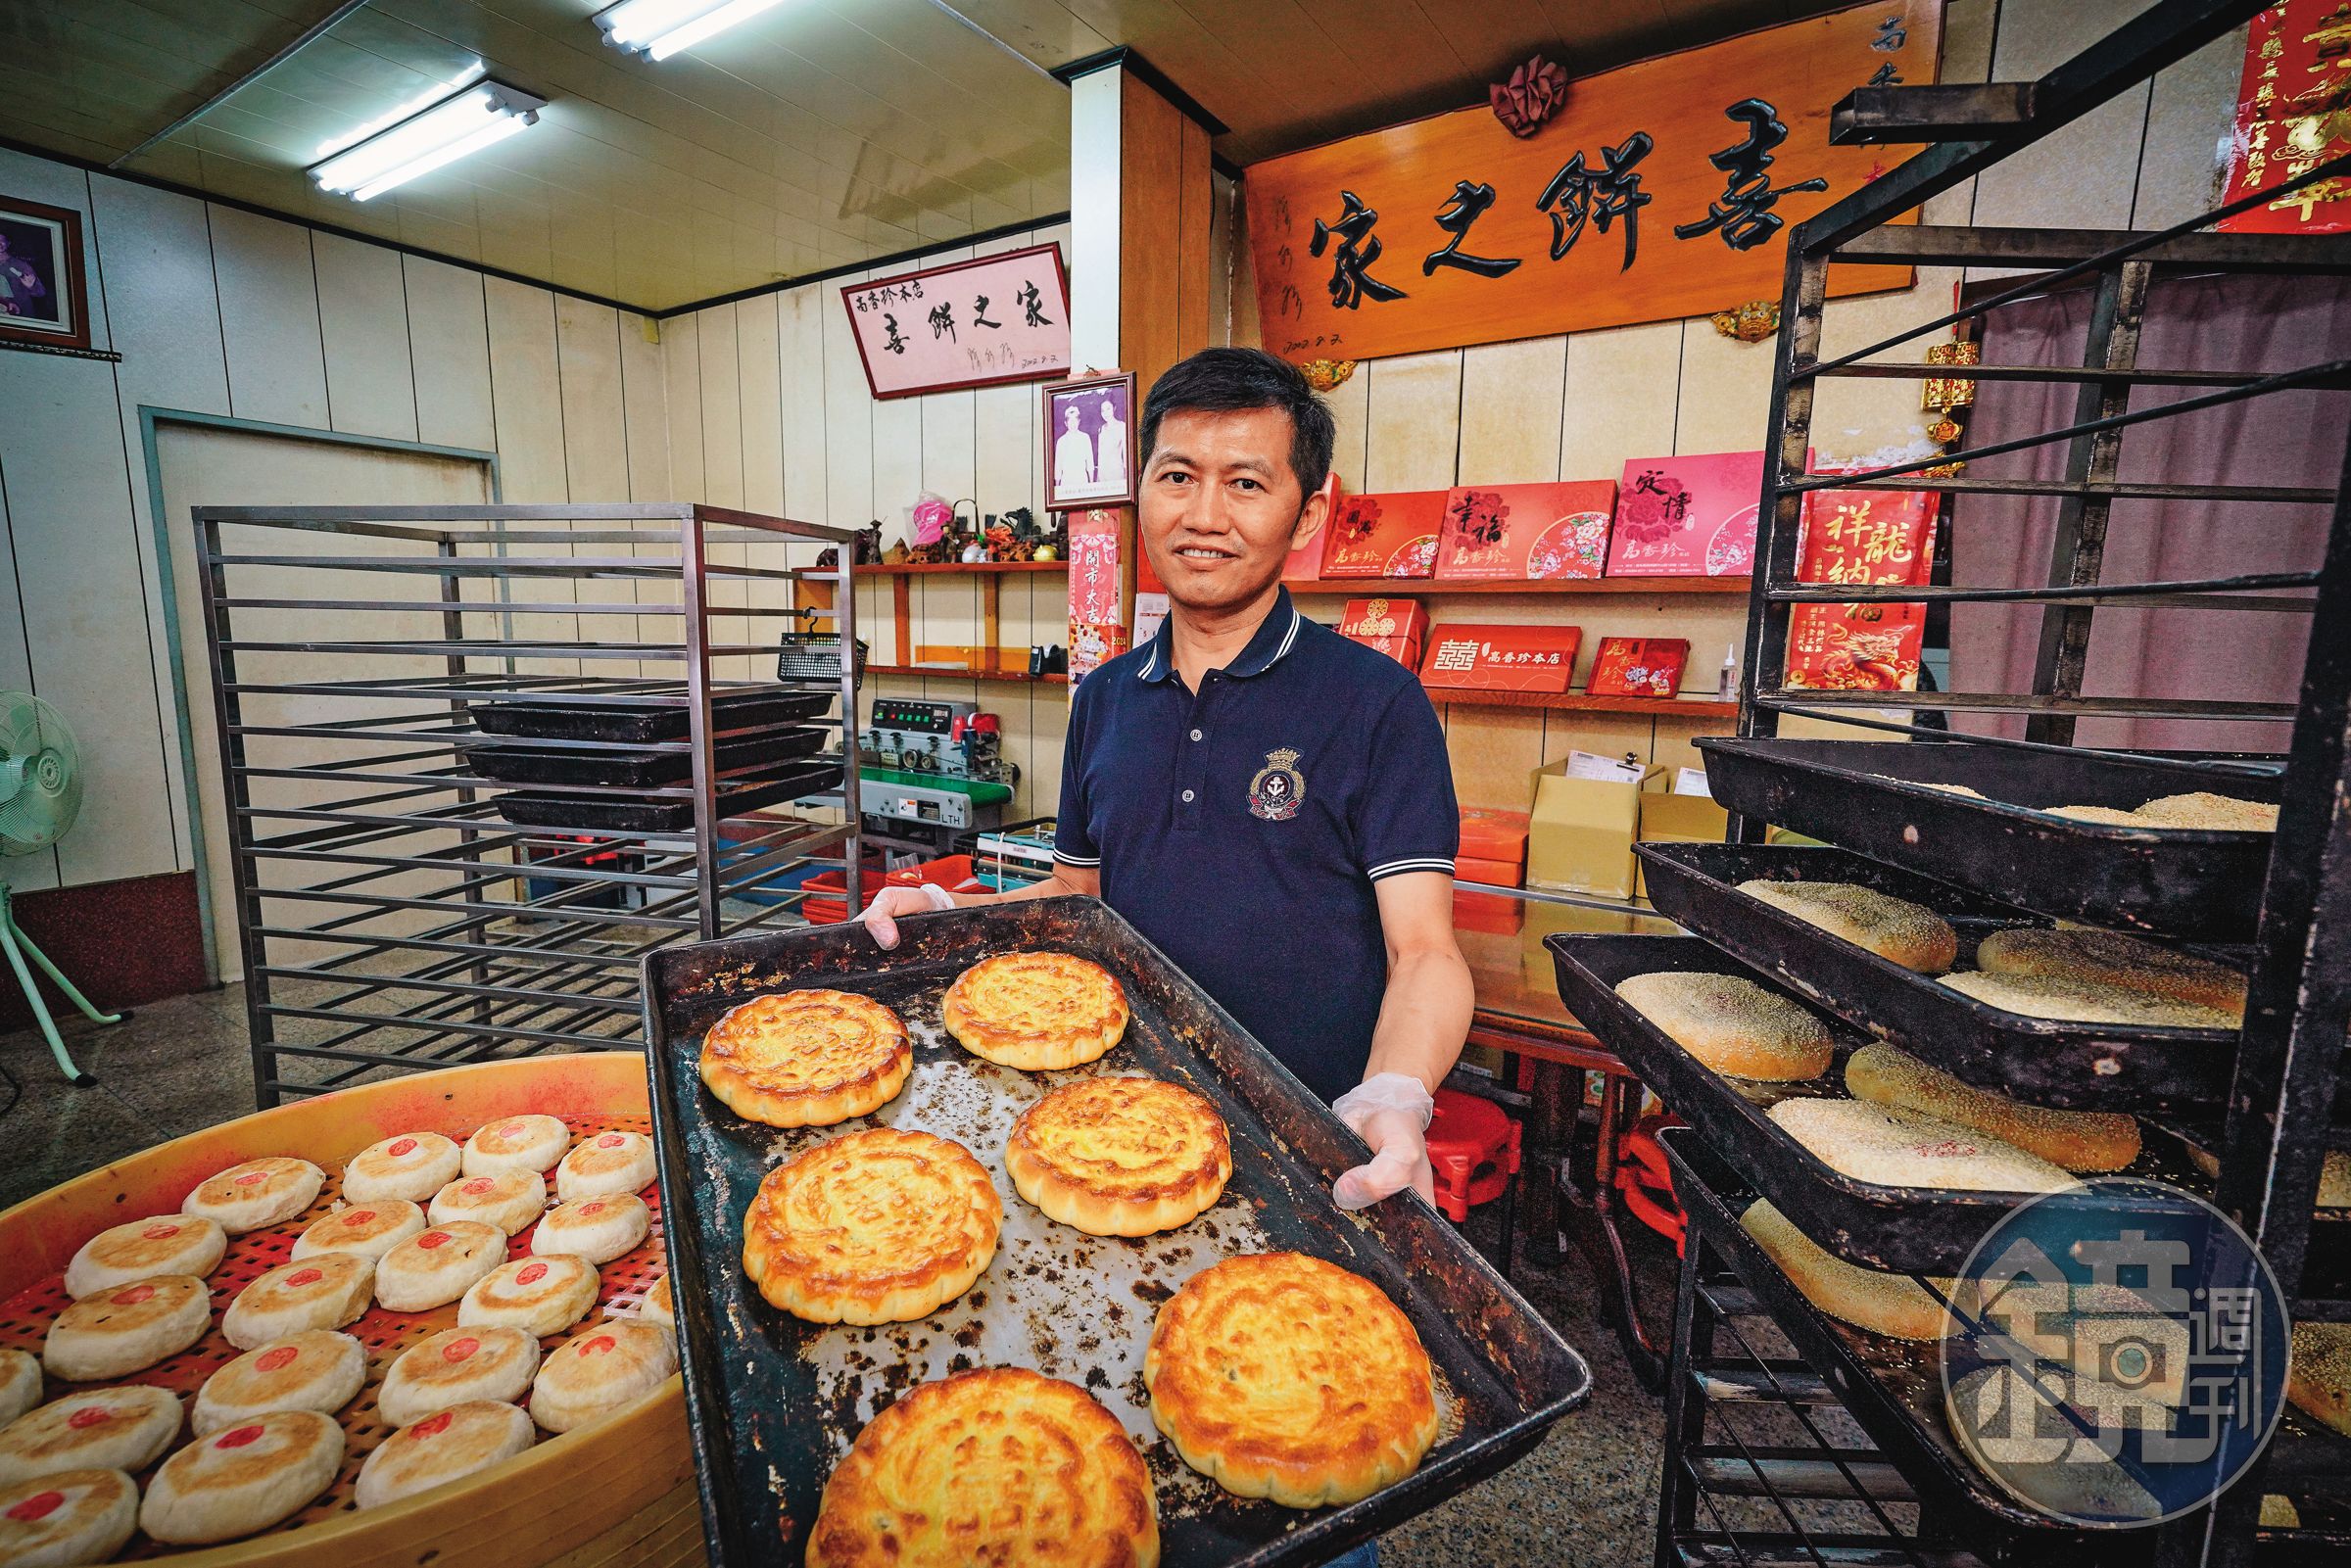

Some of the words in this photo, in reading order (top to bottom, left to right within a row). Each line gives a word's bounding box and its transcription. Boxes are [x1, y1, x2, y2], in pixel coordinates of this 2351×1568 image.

[1309, 98, 1829, 310] 喜餅之家
[883, 280, 1054, 355] 喜餅之家
[1452, 495, 1502, 544] 幸福
[1636, 470, 1692, 520] 定情
[1084, 549, 1101, 624] 開市大吉
[1488, 650, 1561, 665] 高香珍本店
[941, 814, 961, 825] LTH
